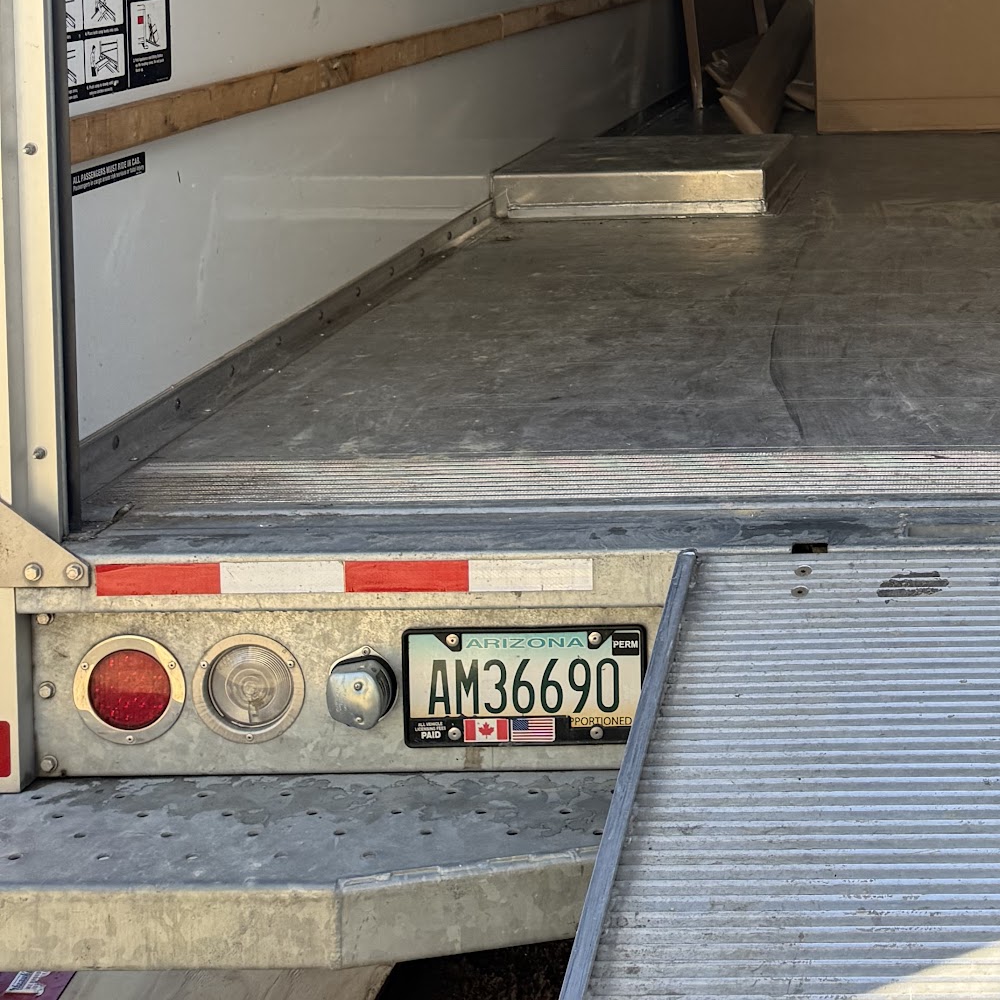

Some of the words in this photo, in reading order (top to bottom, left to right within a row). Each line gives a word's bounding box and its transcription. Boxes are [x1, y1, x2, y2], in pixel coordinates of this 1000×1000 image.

[81, 167, 106, 182] PASSENGERS
[106, 164, 117, 174] MUST
[465, 636, 585, 649] ARIZONA
[613, 640, 638, 648] PERM
[428, 658, 620, 714] AM36690
[421, 731, 441, 739] PAID
